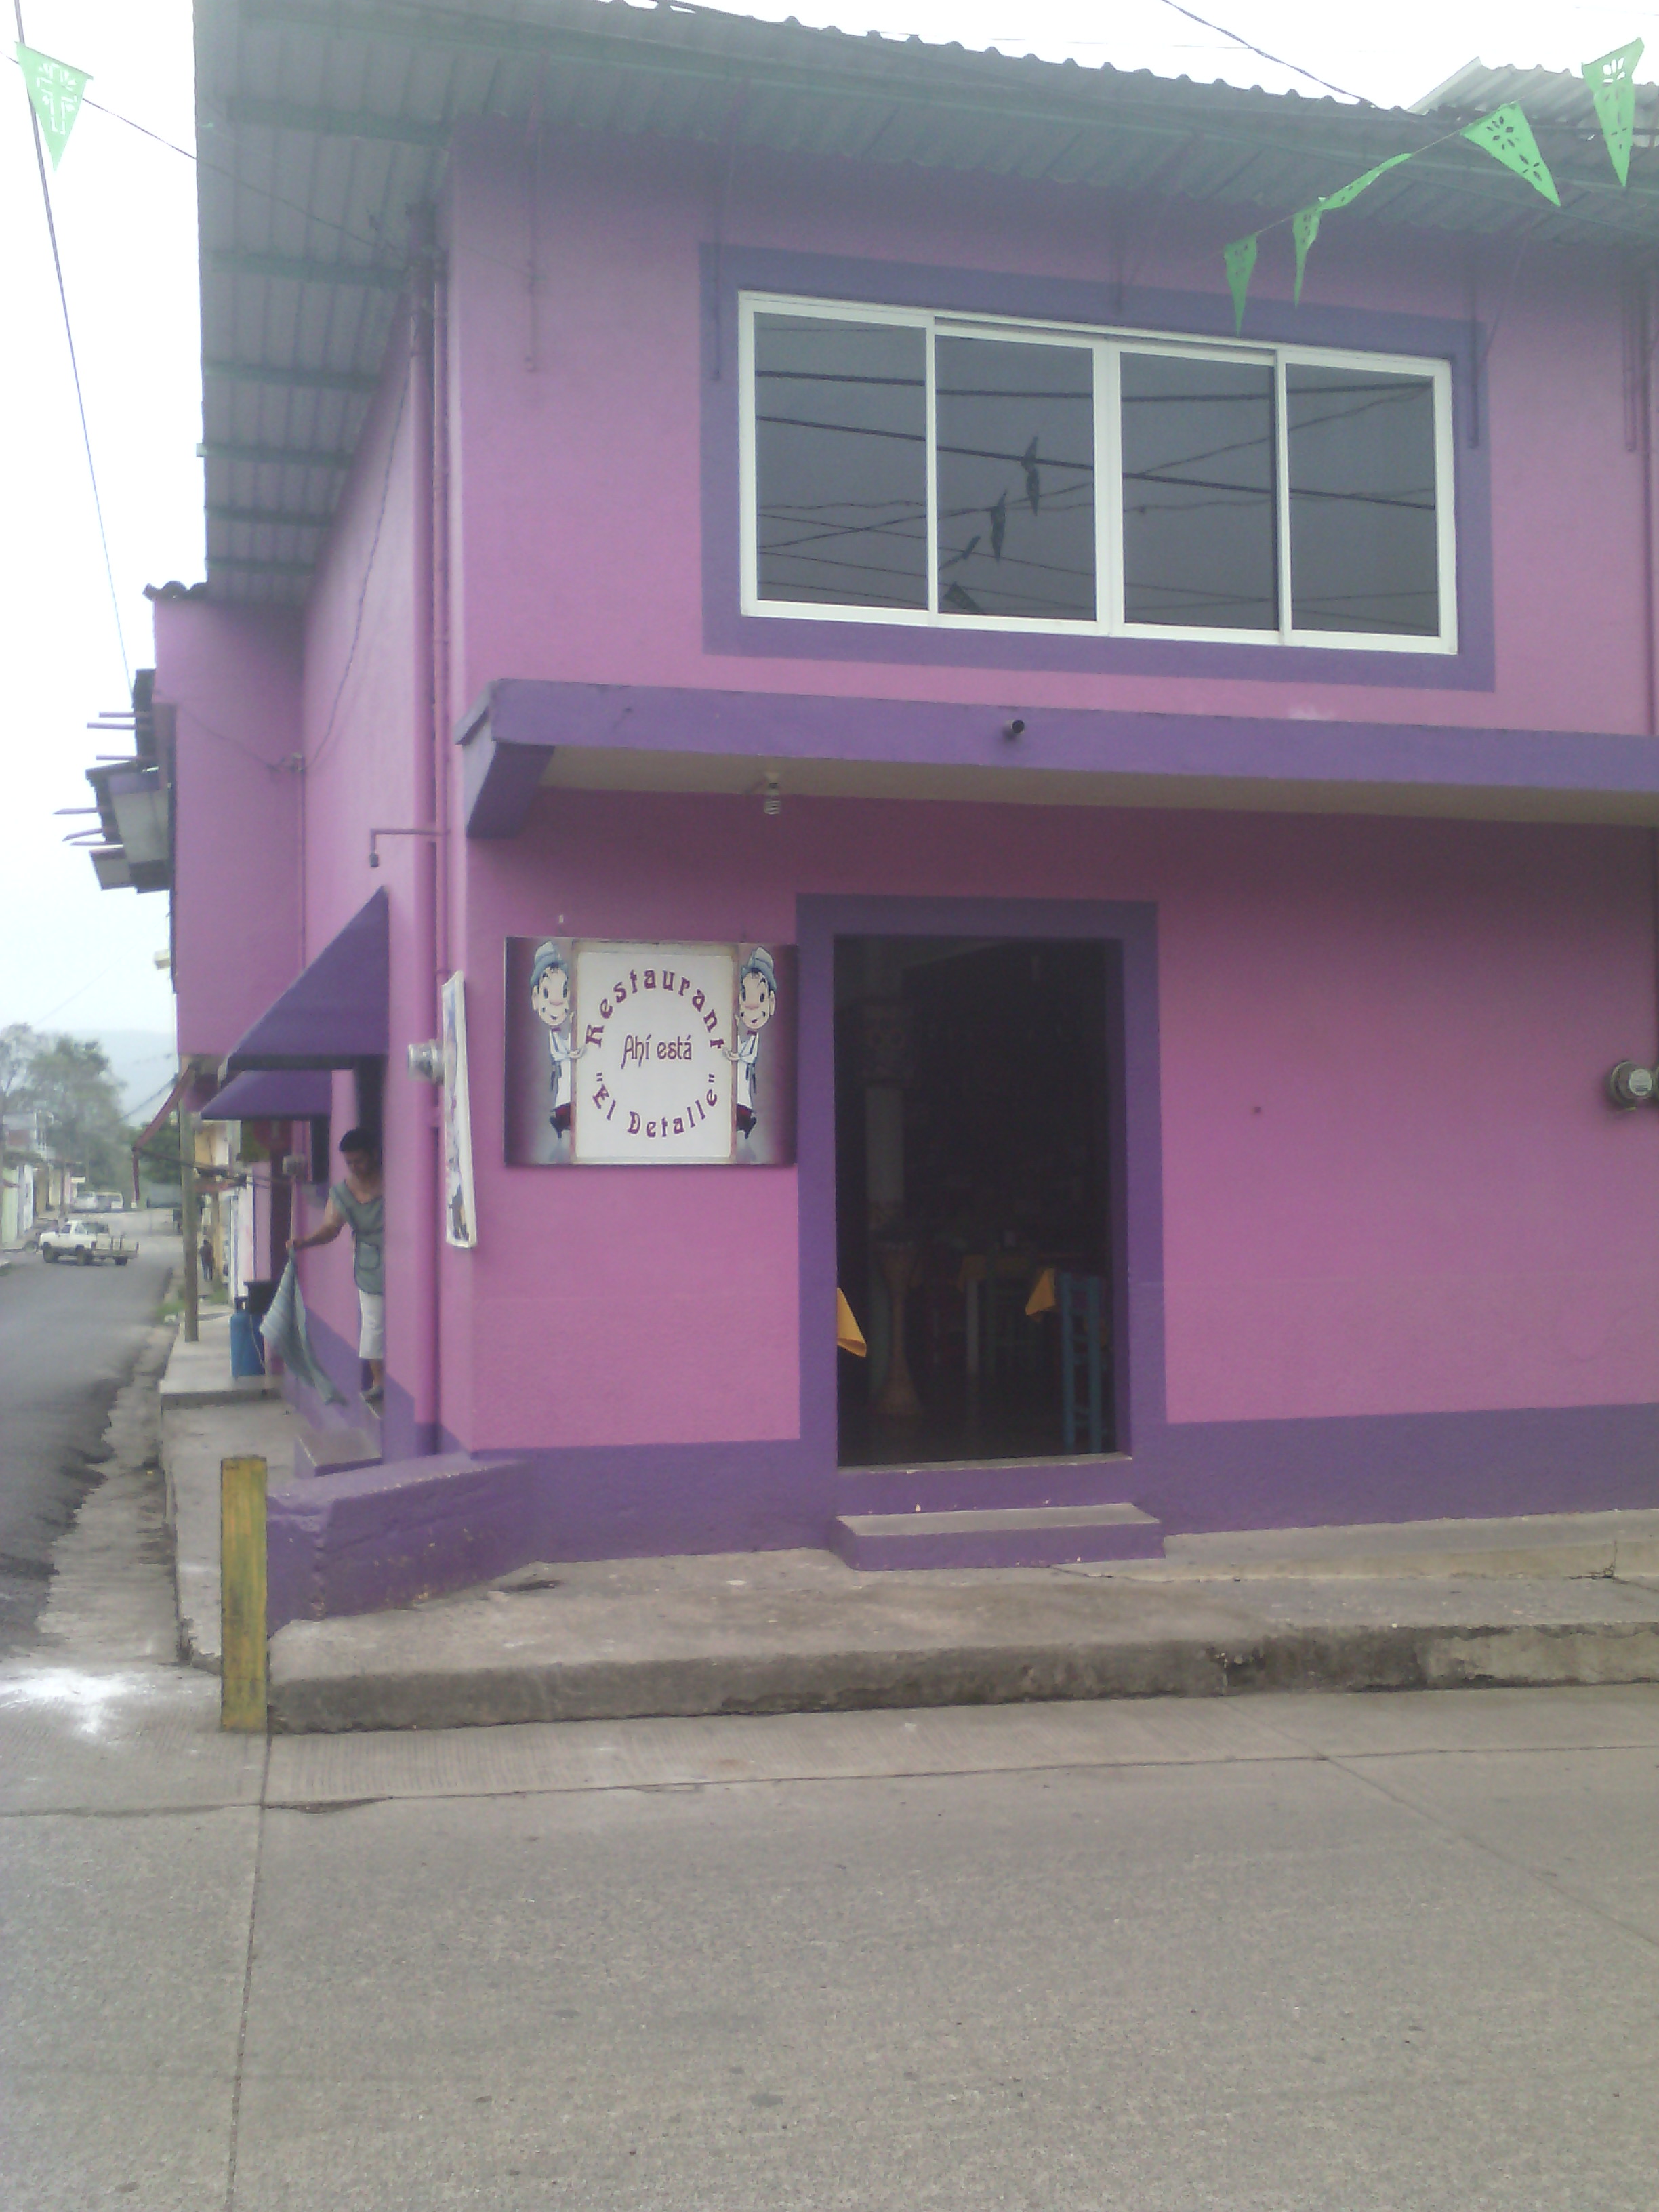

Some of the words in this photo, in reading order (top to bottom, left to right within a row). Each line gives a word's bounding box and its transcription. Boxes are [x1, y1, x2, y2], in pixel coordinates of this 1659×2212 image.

[586, 969, 724, 1050] Restaurant
[621, 1034, 651, 1069] Ahí
[657, 1034, 692, 1061] está
